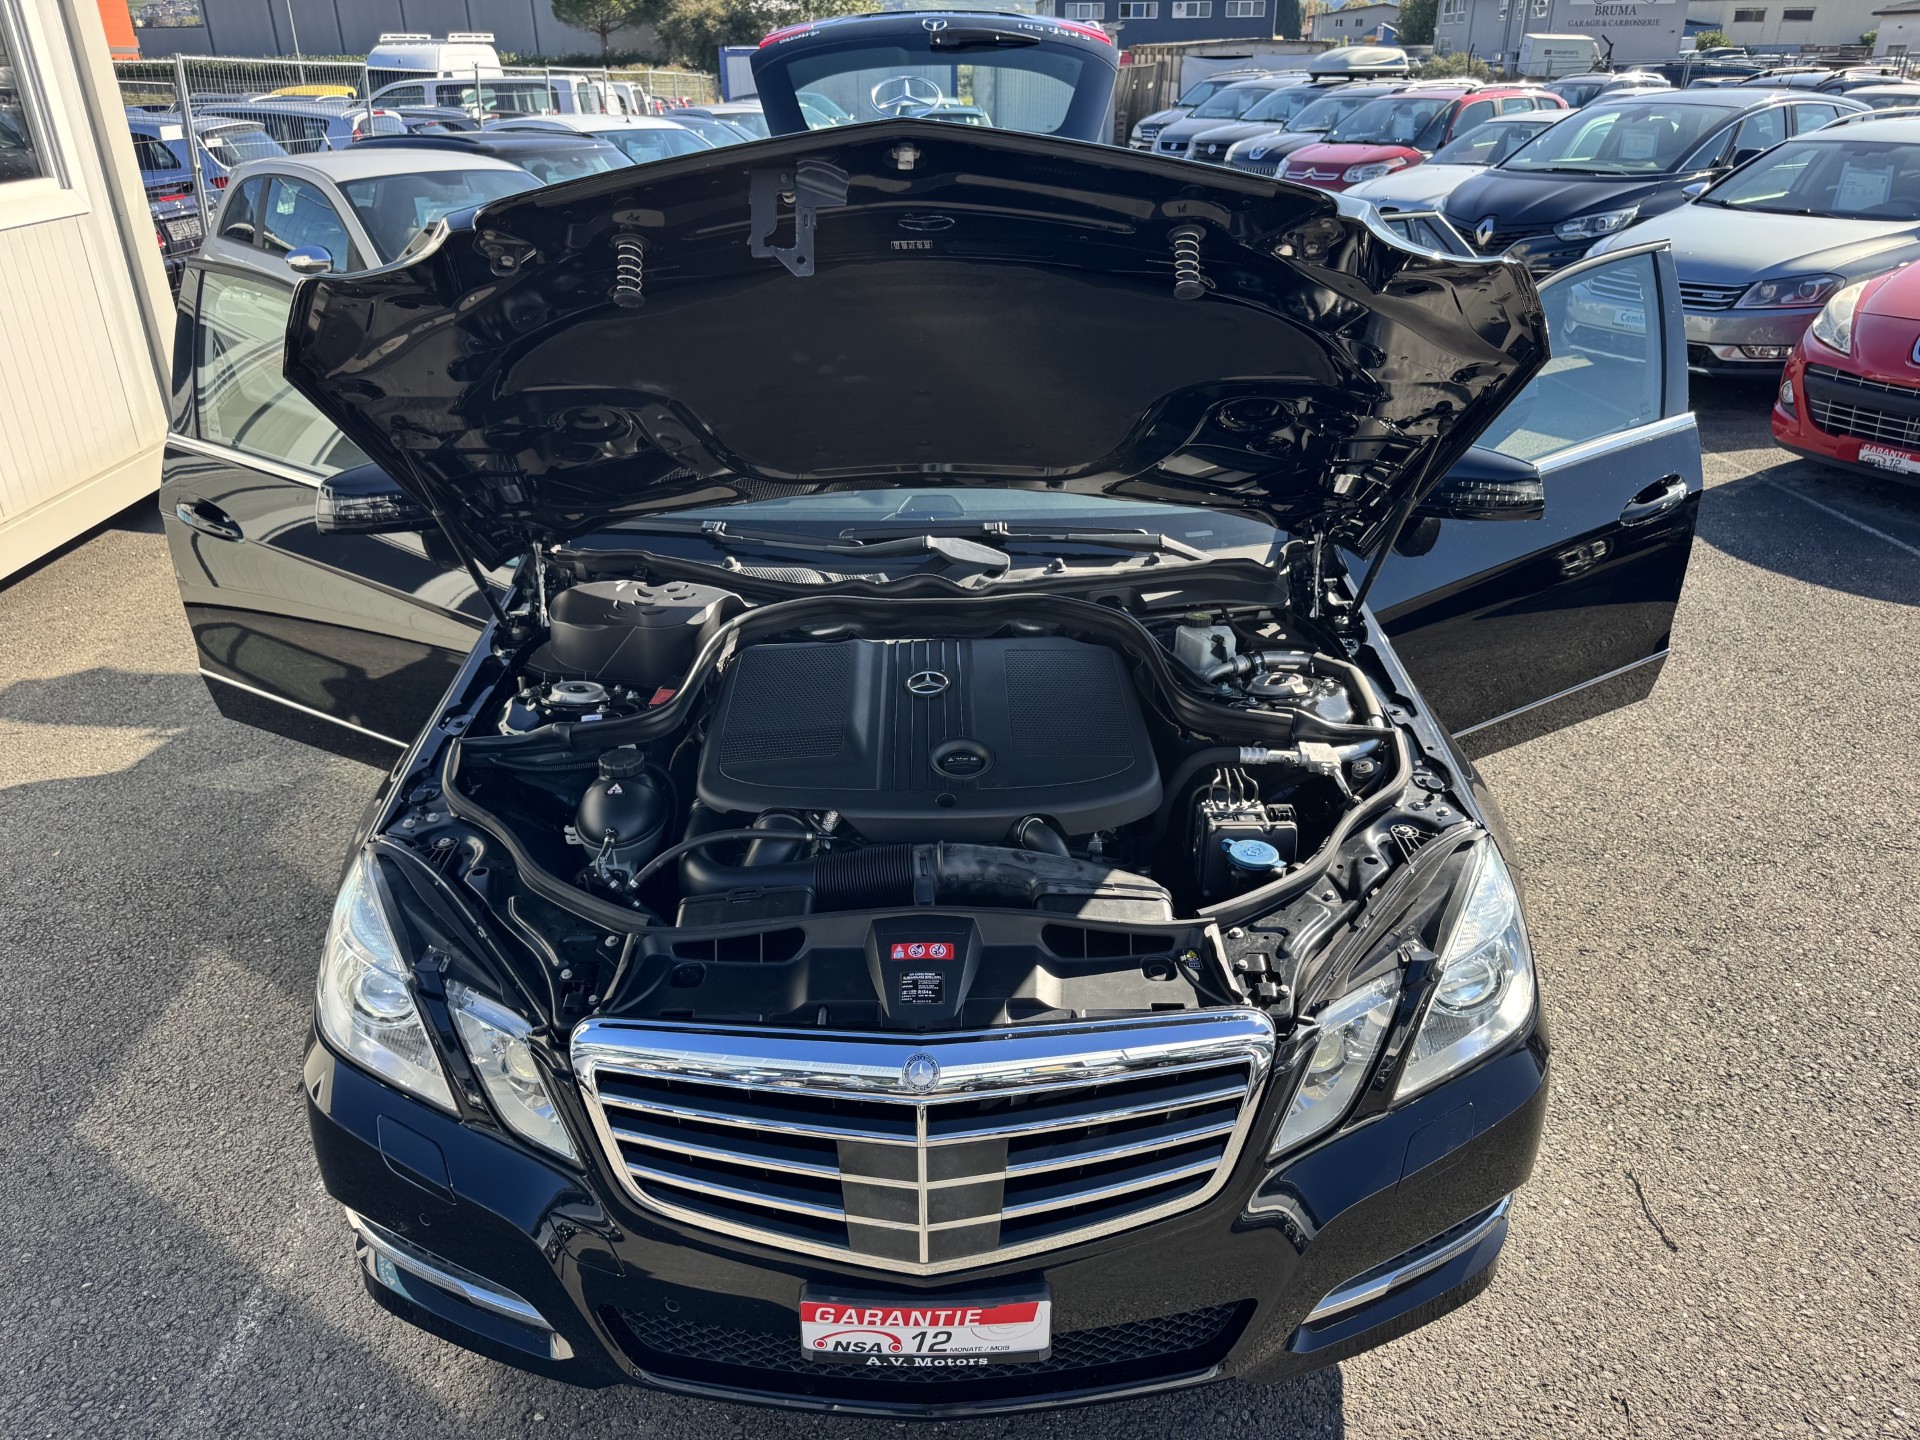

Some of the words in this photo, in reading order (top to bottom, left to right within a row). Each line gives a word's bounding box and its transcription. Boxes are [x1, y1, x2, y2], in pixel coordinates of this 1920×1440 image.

[1595, 5, 1637, 16] BRUMA
[1568, 19, 1601, 27] GARAGE
[1608, 18, 1661, 27] CARROSSERIE
[1863, 444, 1911, 460] GARANTIE
[1889, 458, 1901, 467] 12
[814, 1307, 983, 1326] GARANTIE
[832, 1340, 883, 1354] NSA
[911, 1331, 953, 1353] 12
[865, 1356, 908, 1367] A.V.
[914, 1356, 988, 1367] Motors
